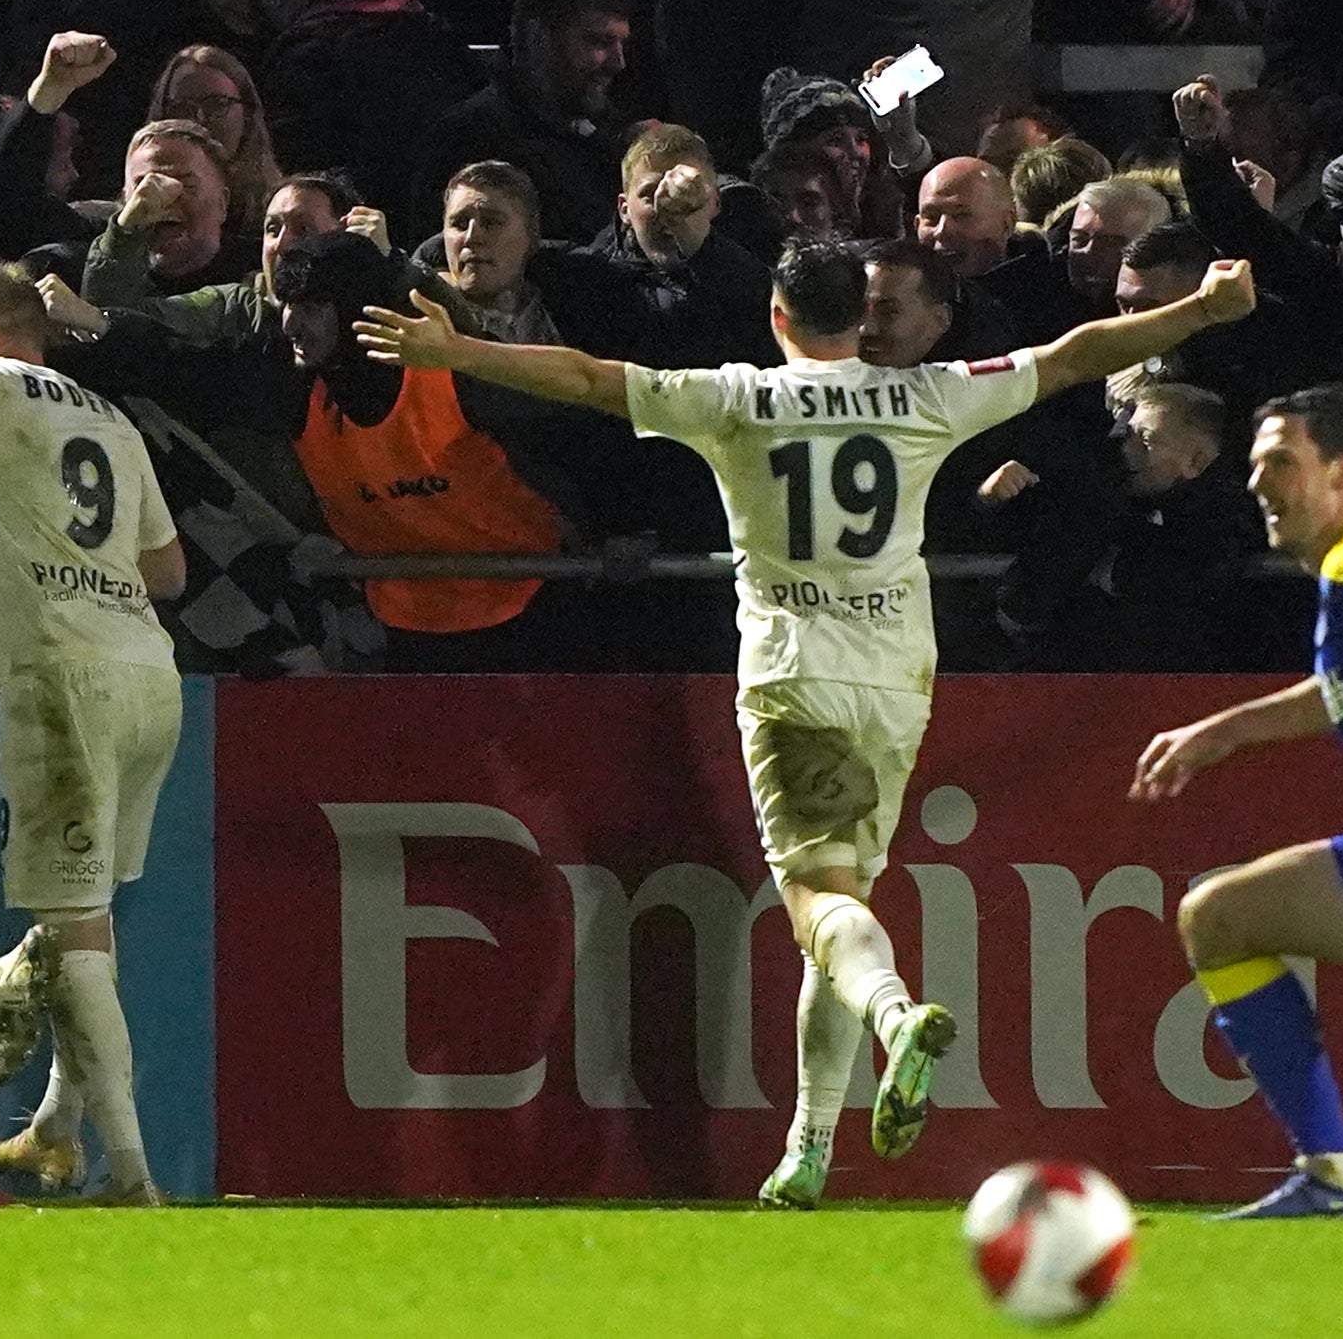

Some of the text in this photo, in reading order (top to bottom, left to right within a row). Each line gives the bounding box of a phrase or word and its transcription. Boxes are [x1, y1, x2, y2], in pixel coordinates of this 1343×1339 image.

[23, 373, 117, 423] BODEN
[755, 383, 910, 420] K SMITH
[60, 436, 116, 551] 9
[767, 432, 900, 561] 19
[48, 859, 106, 876] GRIGGS
